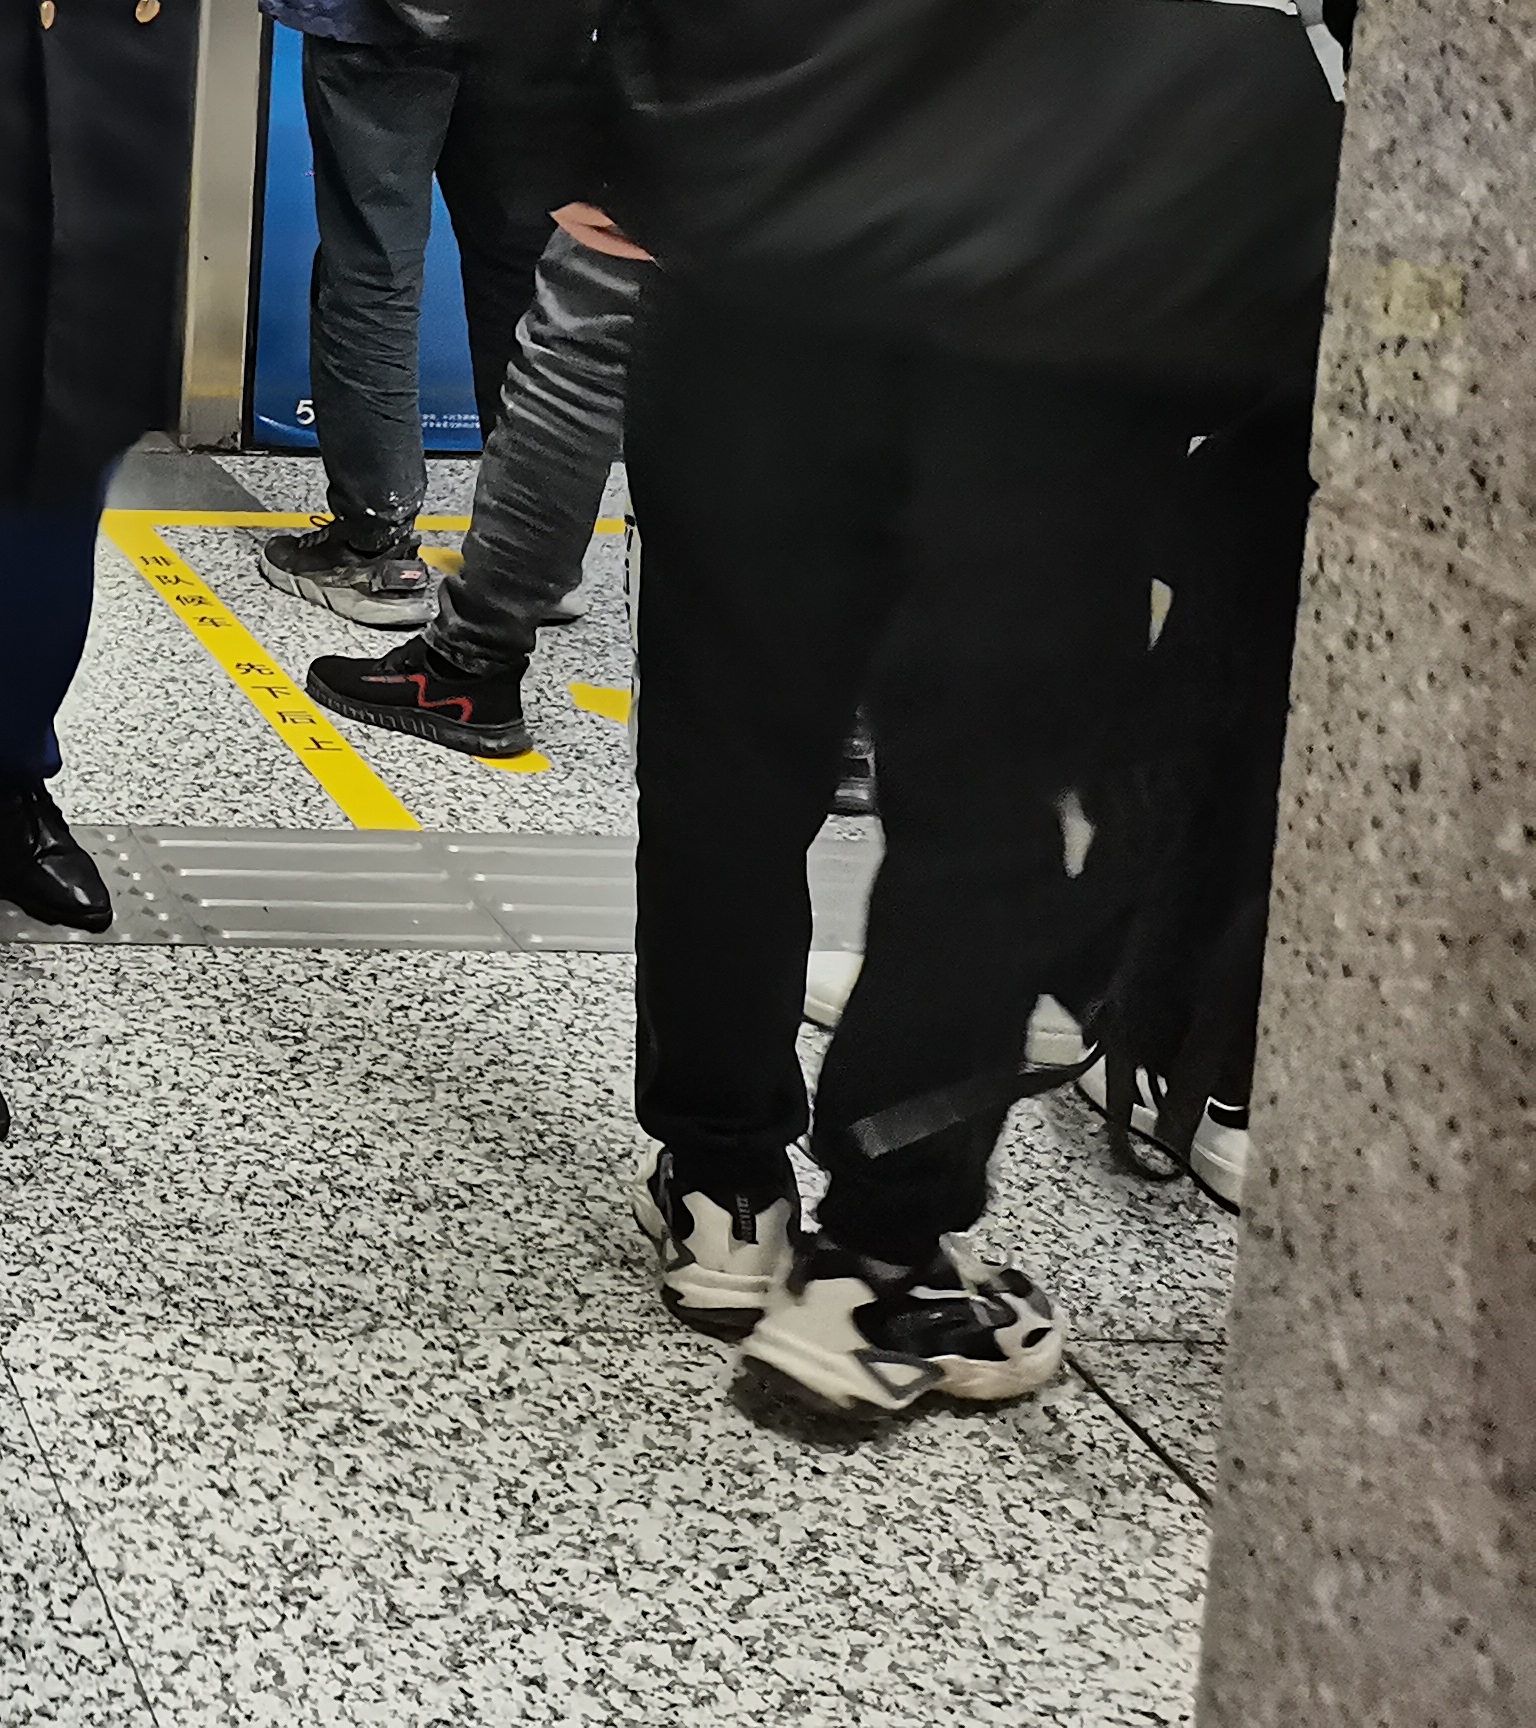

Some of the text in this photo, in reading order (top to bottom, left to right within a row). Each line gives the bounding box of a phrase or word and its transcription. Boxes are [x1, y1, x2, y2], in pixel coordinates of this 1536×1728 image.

[139, 553, 343, 754] 排队候车 先下后上
